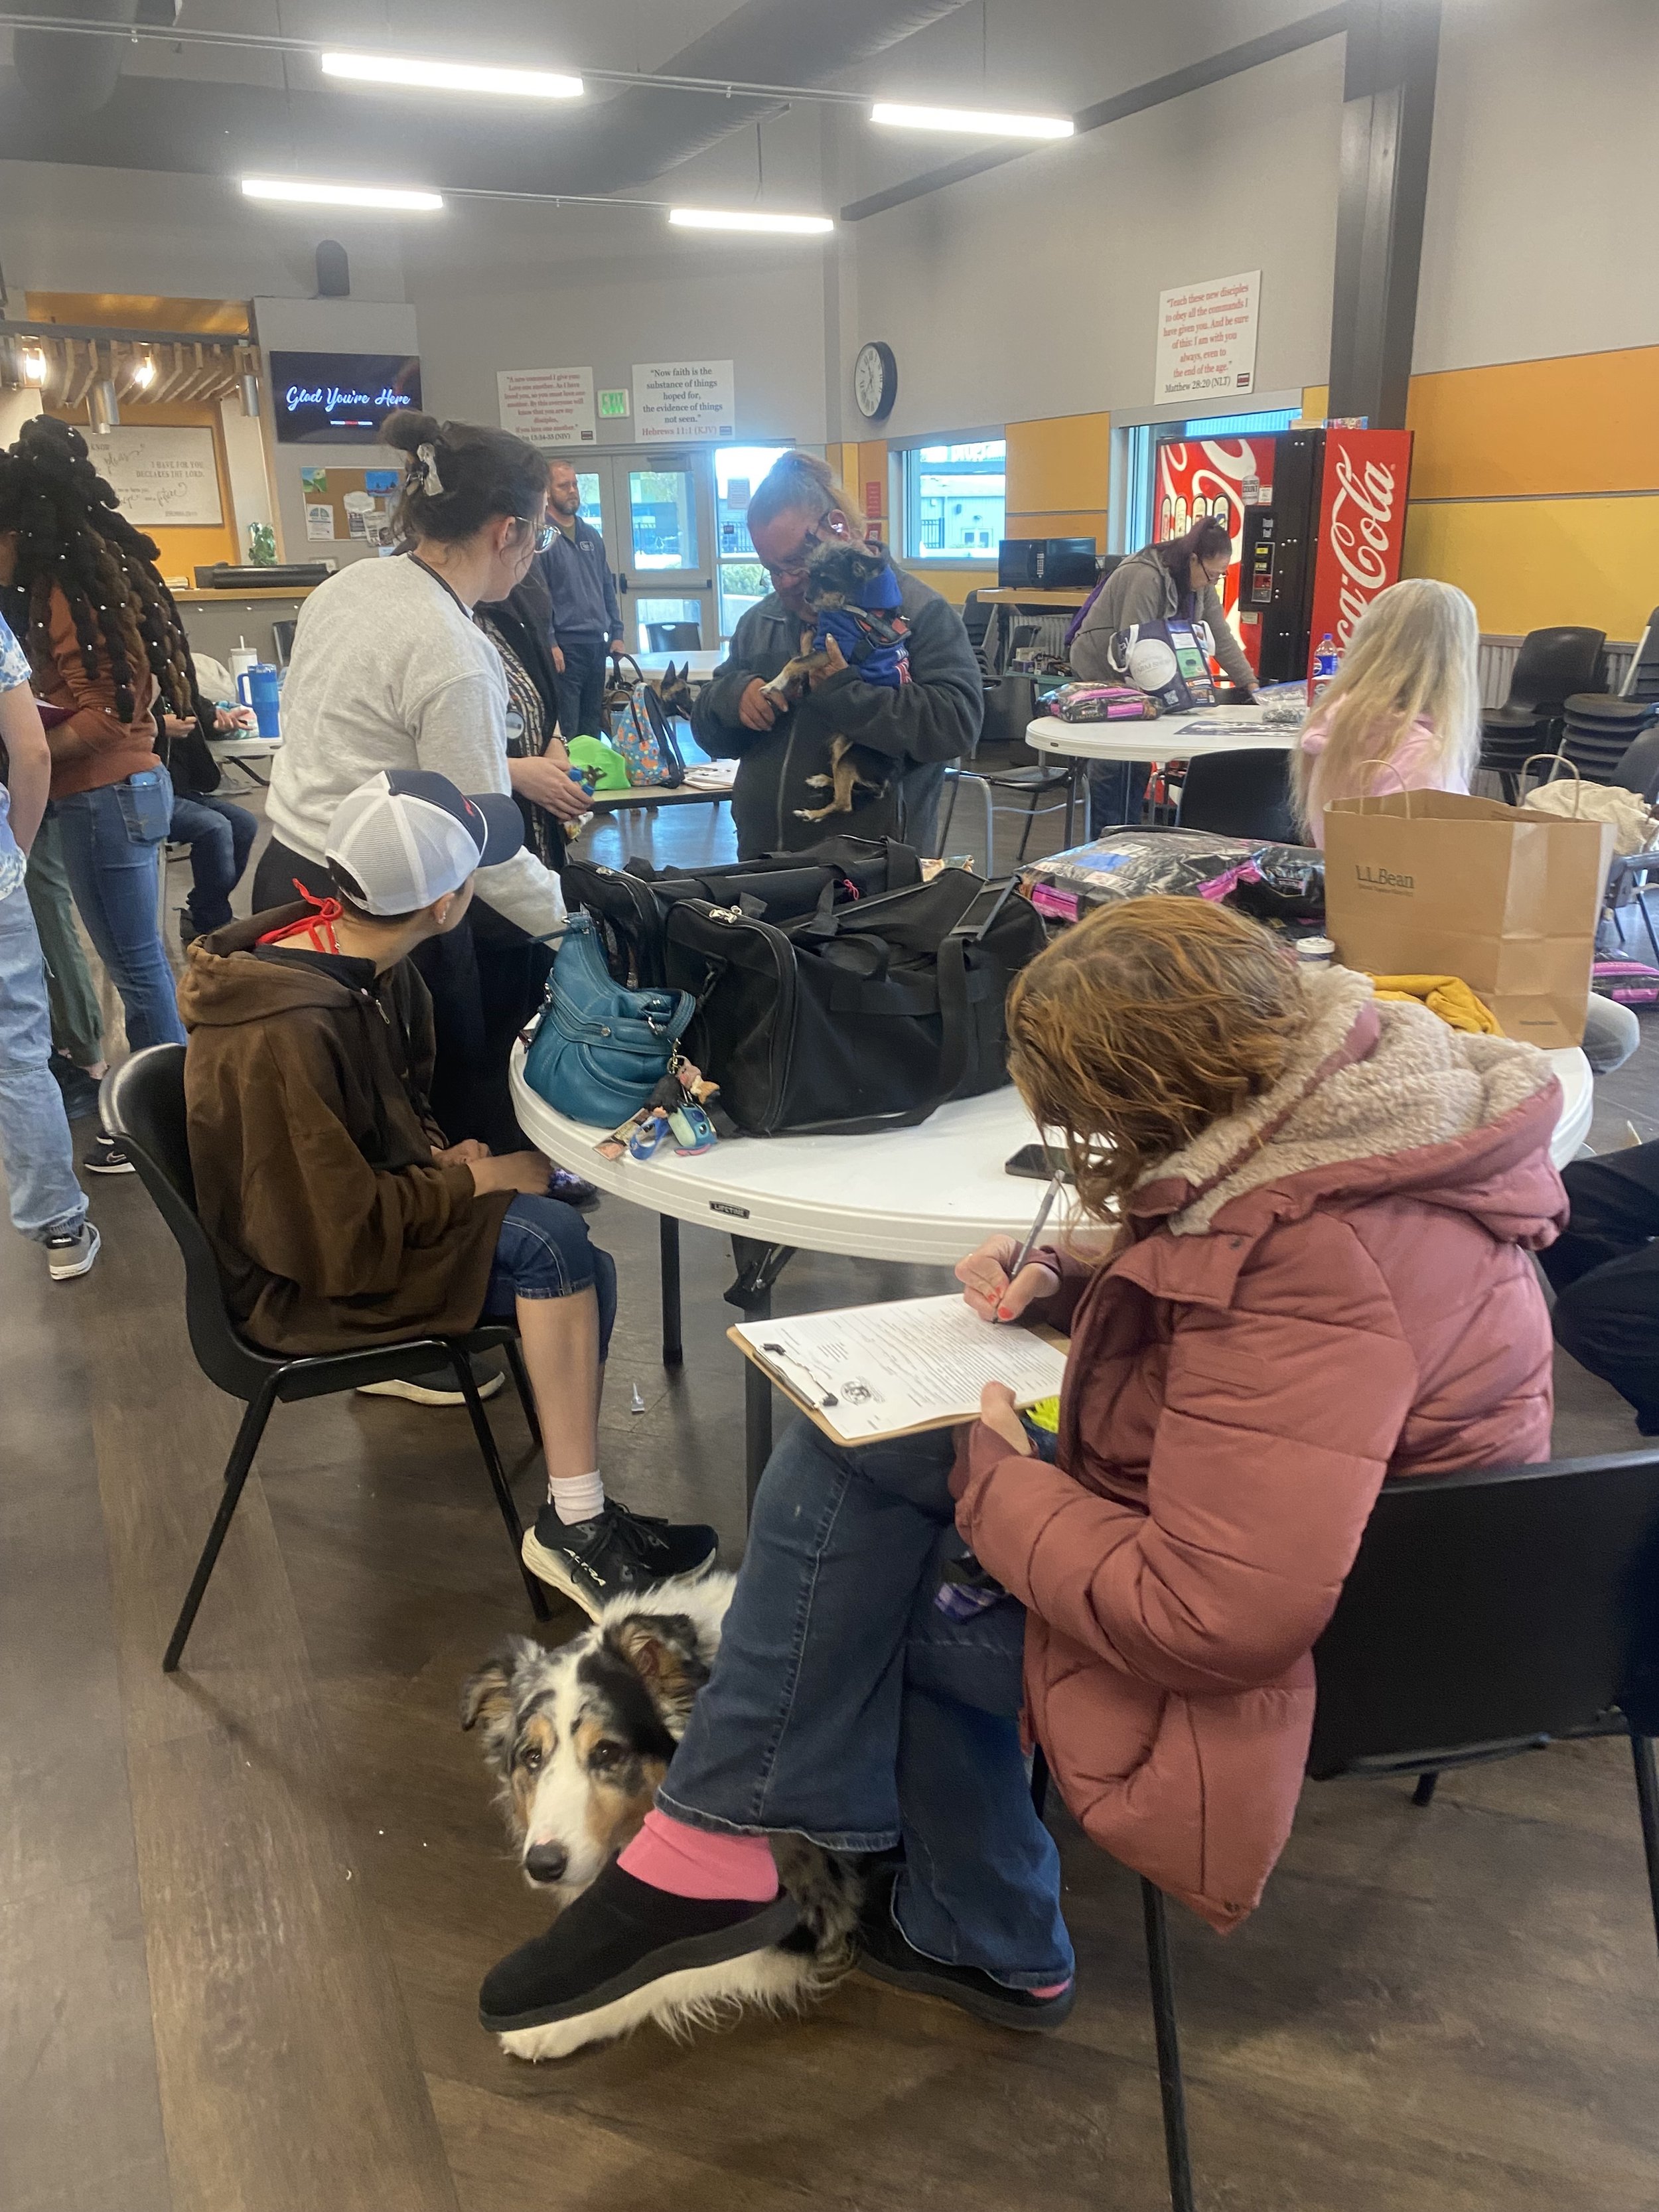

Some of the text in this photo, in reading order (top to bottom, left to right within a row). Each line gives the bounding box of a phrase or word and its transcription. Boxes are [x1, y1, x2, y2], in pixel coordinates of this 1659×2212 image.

[1189, 293, 1205, 303] these
[1206, 291, 1219, 300] new
[1220, 283, 1249, 297] disciples
[1173, 311, 1187, 321] obey
[1197, 307, 1207, 316] the
[1208, 299, 1244, 314] commands
[1246, 298, 1248, 307] I
[1163, 327, 1177, 336] have
[1179, 324, 1194, 336] given
[1211, 317, 1224, 329] And
[1225, 316, 1233, 326] be
[1234, 315, 1249, 324] sure
[1172, 339, 1179, 349] of
[1194, 337, 1197, 346] I
[1210, 332, 1224, 342] with
[1224, 332, 1237, 342] you
[1180, 352, 1202, 363] always,
[1203, 350, 1218, 359] even
[1173, 368, 1183, 378] the
[1184, 366, 1195, 376] end
[1197, 364, 1204, 374] of
[1204, 363, 1214, 373] the
[694, 380, 717, 388] things
[1165, 382, 1190, 394] Matthew
[1192, 378, 1211, 390] 28:20
[1212, 376, 1230, 388] (NLT)
[286, 386, 323, 411] Glad
[374, 388, 411, 407] Here
[602, 392, 624, 415] EXIT
[664, 392, 685, 402] hoped
[699, 403, 723, 411] things
[694, 426, 717, 435] (KJV)
[562, 1547, 607, 1587] ALTRA
